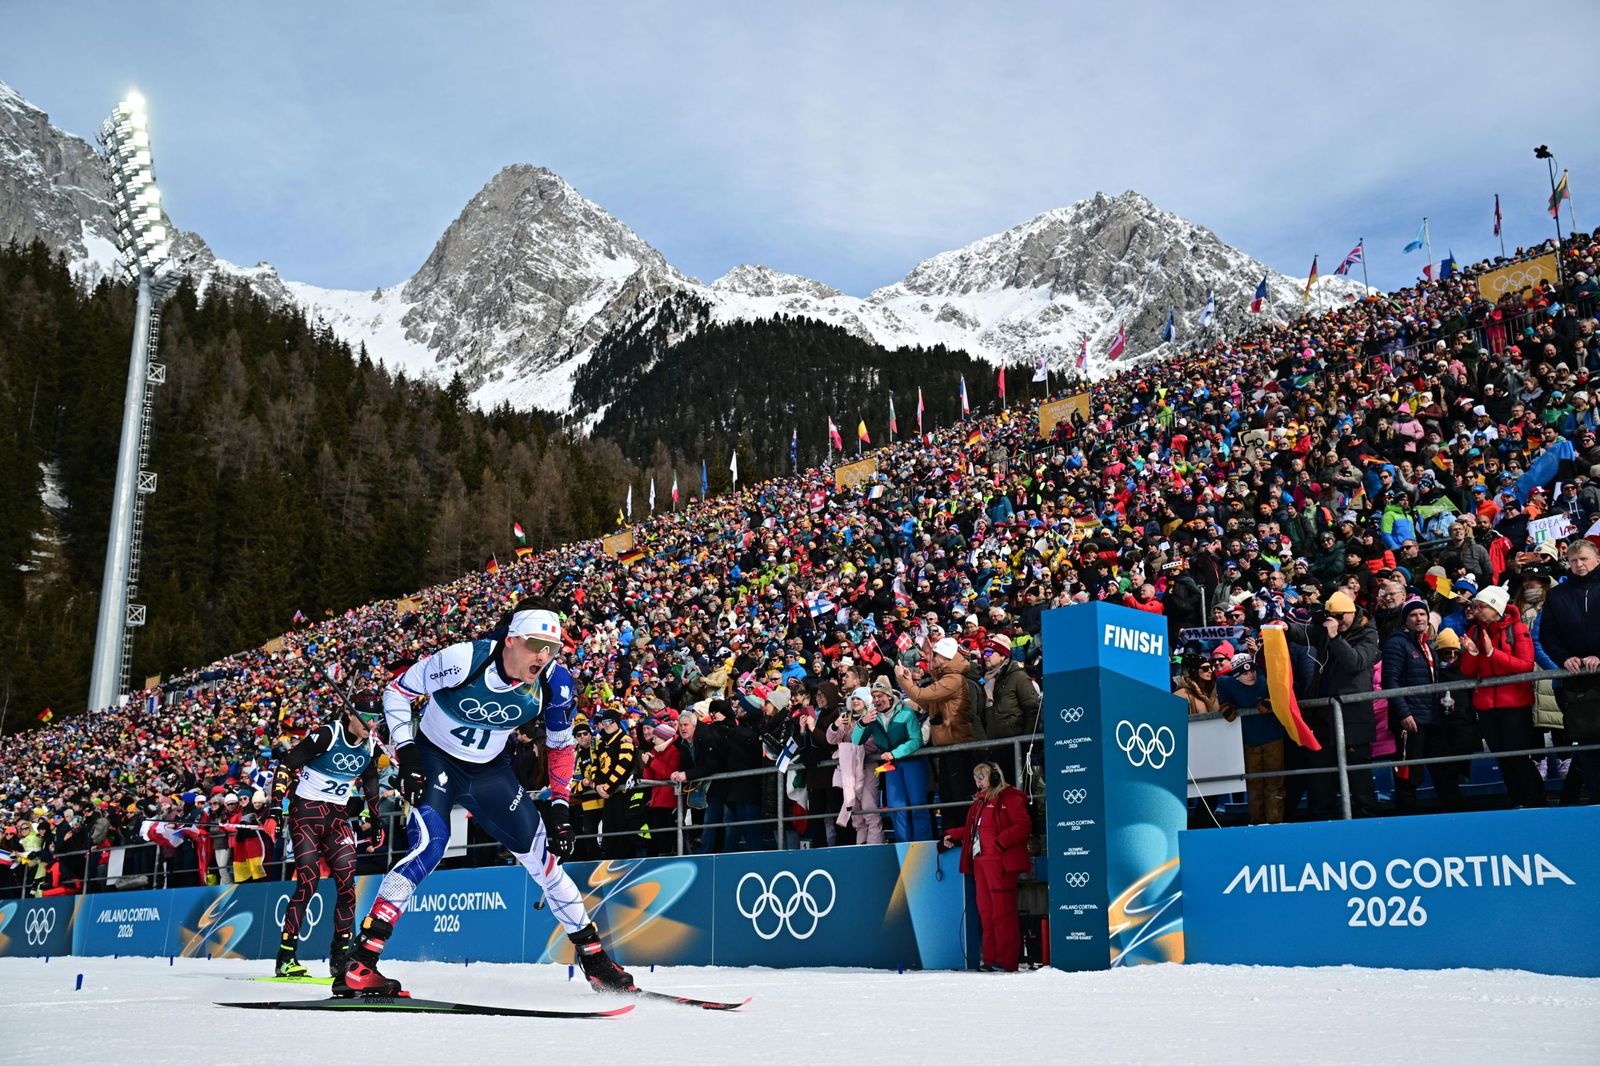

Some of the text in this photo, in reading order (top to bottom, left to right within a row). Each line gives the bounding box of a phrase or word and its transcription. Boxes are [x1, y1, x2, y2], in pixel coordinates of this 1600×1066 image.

[1104, 624, 1163, 656] FINISH
[1186, 627, 1234, 639] FRANCE
[430, 668, 453, 680] CRAFT
[450, 725, 492, 750] 41
[321, 779, 350, 797] 26
[1222, 853, 1576, 895] MILANO CORTINA
[448, 891, 507, 912] CORTINA
[96, 907, 160, 923] MILANO CORTINA
[1347, 896, 1428, 928] 2026
[117, 924, 134, 938] 2026
[434, 914, 461, 933] 2026
